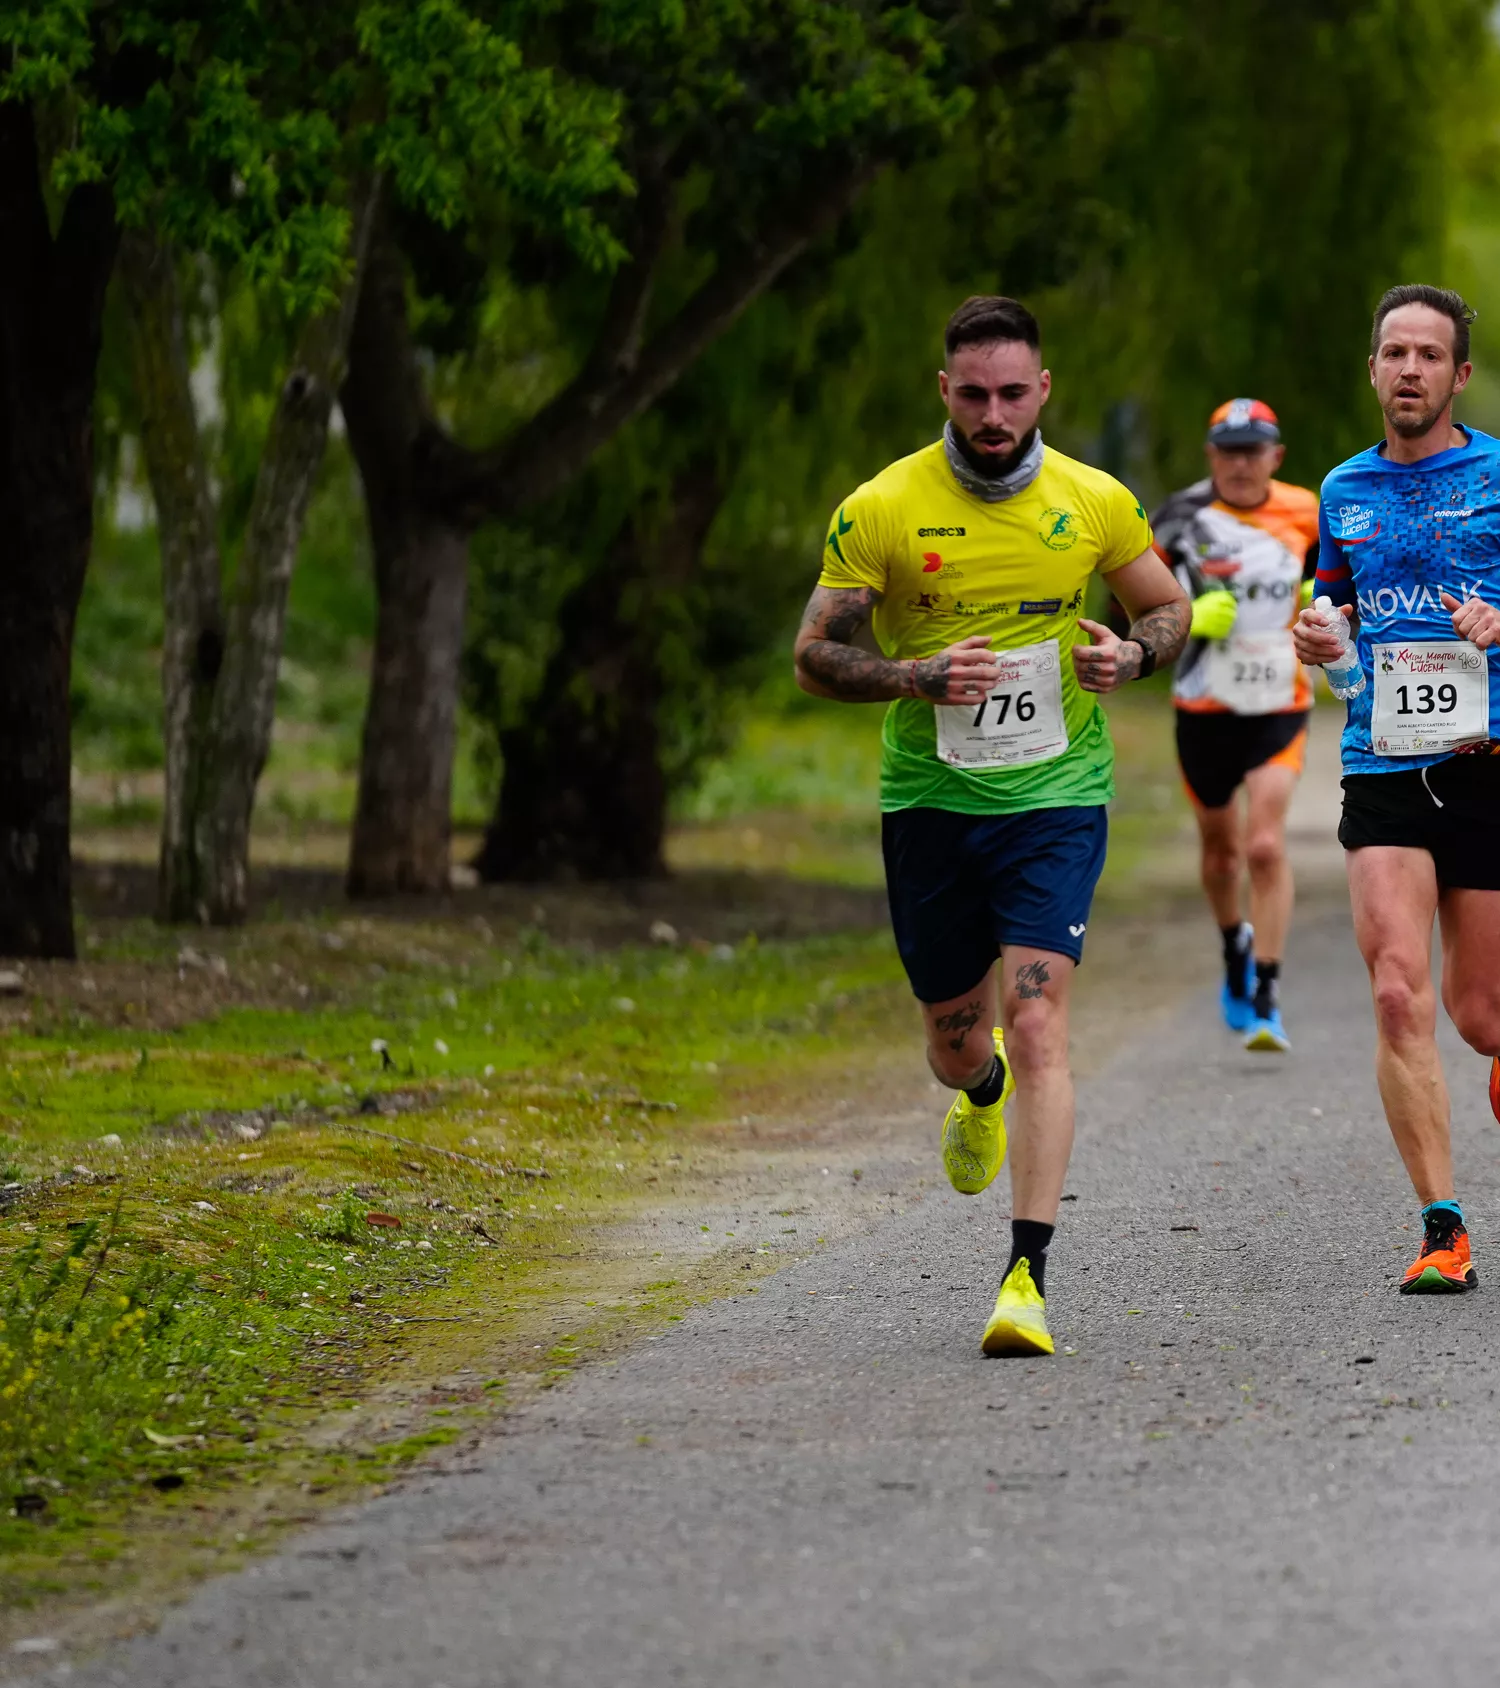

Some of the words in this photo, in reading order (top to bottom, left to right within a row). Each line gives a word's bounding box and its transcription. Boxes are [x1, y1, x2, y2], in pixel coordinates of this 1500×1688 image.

[1339, 504, 1361, 518] Club
[1342, 509, 1374, 528] Maratón
[1434, 509, 1473, 518] enerplus
[1341, 520, 1371, 536] Lucena
[1396, 683, 1458, 715] 139
